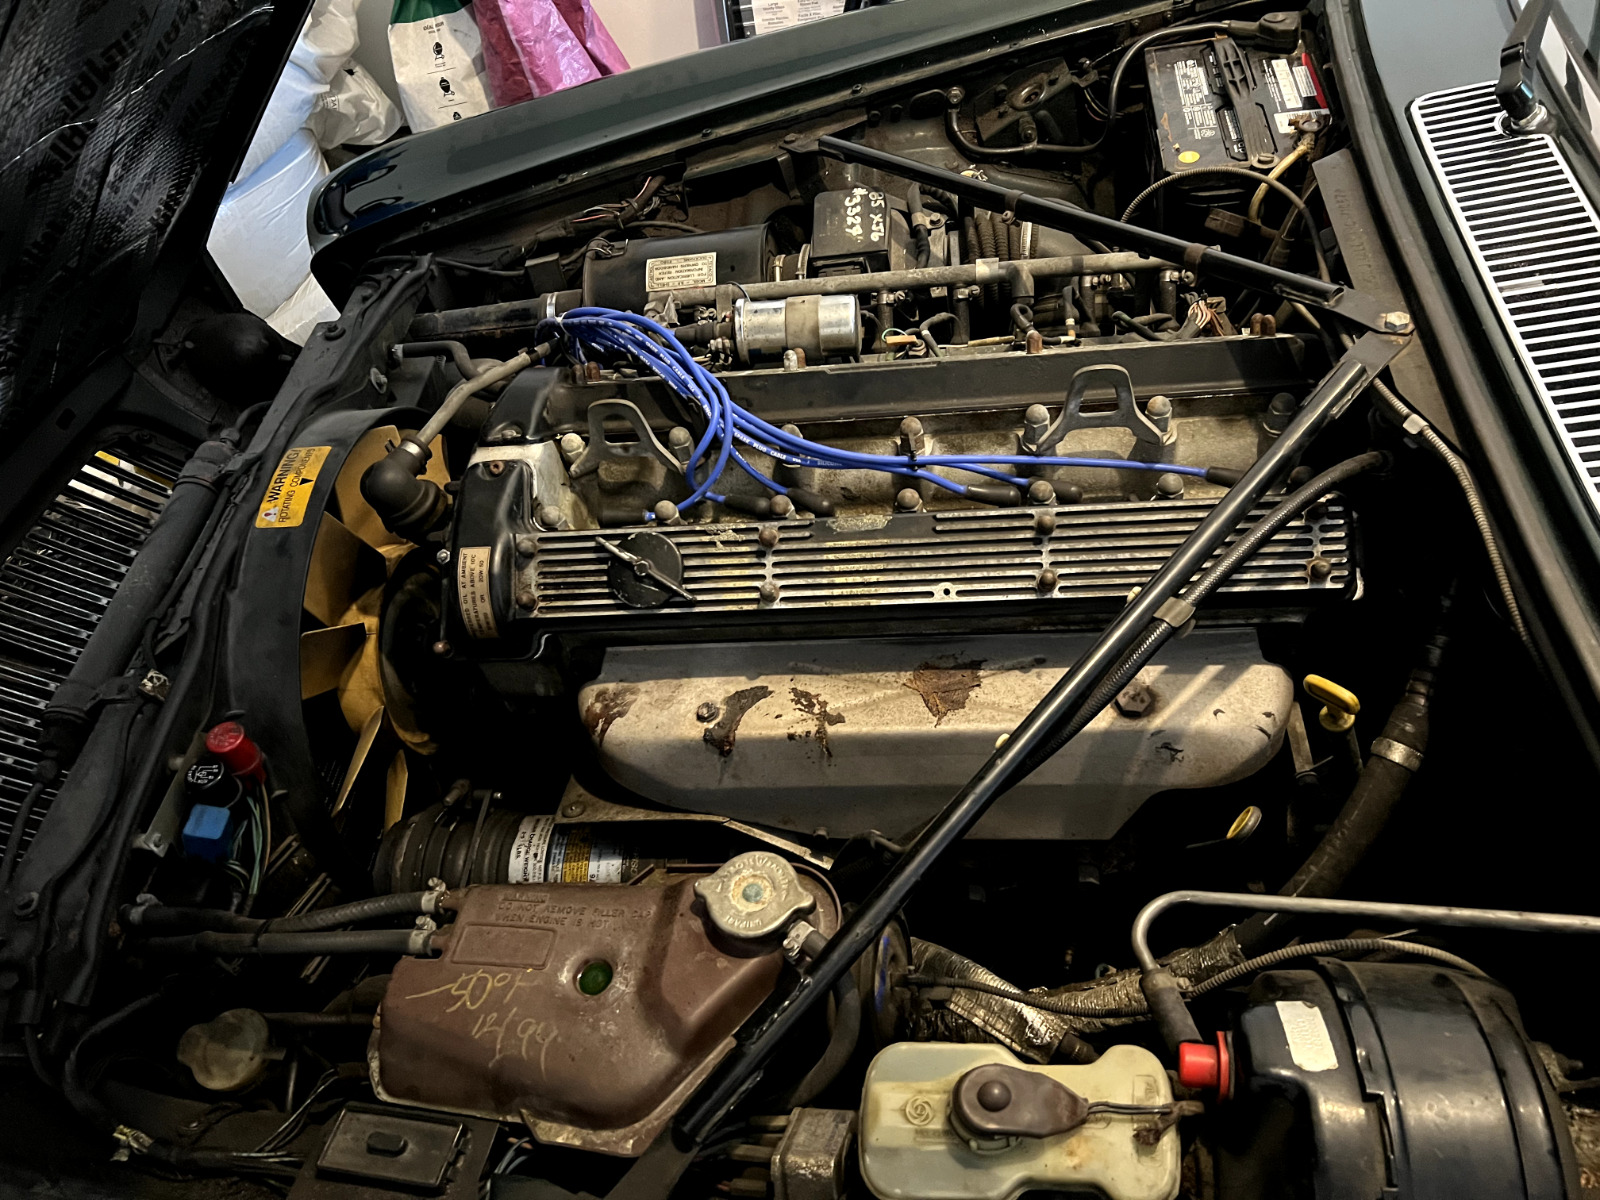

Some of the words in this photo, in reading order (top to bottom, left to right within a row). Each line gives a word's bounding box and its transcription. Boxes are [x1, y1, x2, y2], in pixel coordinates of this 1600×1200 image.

[752, 442, 767, 453] PLUG
[770, 451, 787, 461] CABLE
[266, 449, 302, 504] WARNING!
[279, 490, 296, 523] ROTATING
[290, 448, 315, 488] COMPONENTS
[460, 553, 468, 579] AMBIENT
[530, 914, 568, 926] ENGINE
[546, 905, 587, 916] REMOVE
